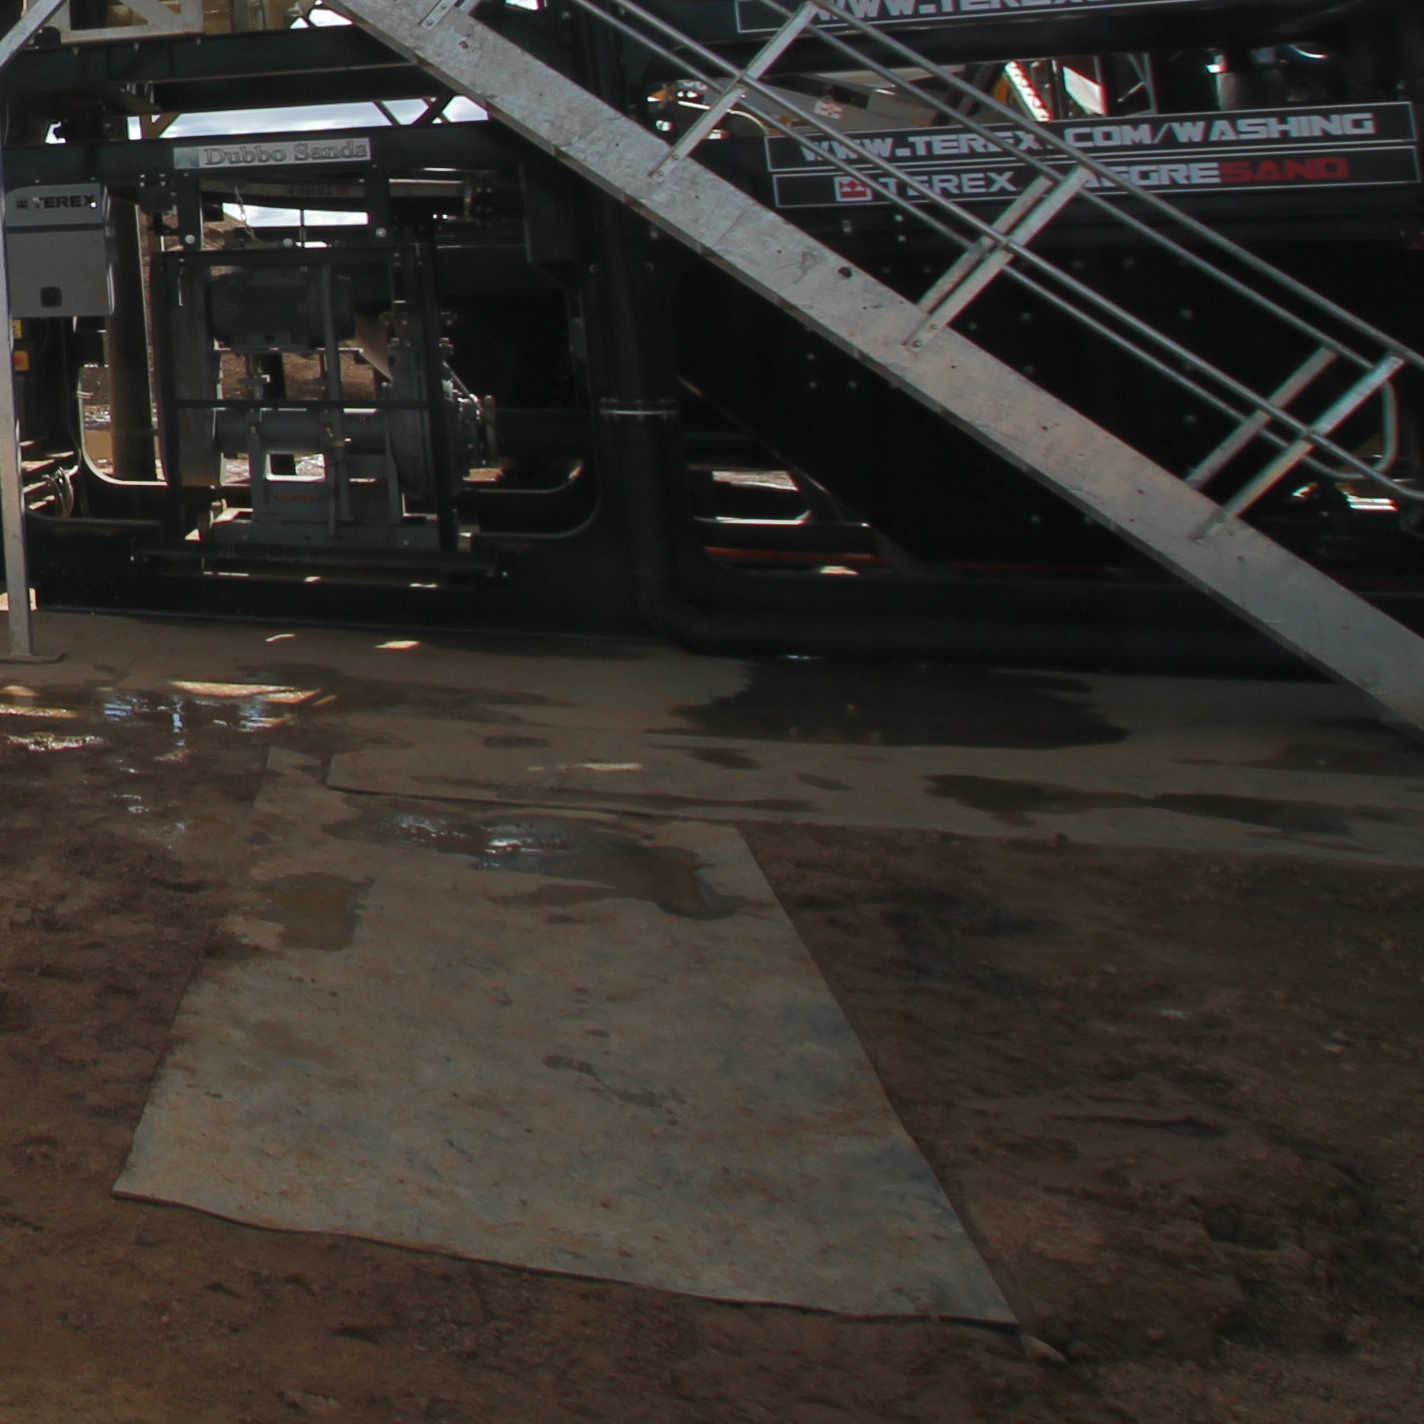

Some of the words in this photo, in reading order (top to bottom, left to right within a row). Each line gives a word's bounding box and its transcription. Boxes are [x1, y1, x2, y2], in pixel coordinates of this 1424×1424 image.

[204, 146, 287, 166] Dubbo
[294, 141, 367, 162] Sands
[31, 194, 96, 209] TEREX
